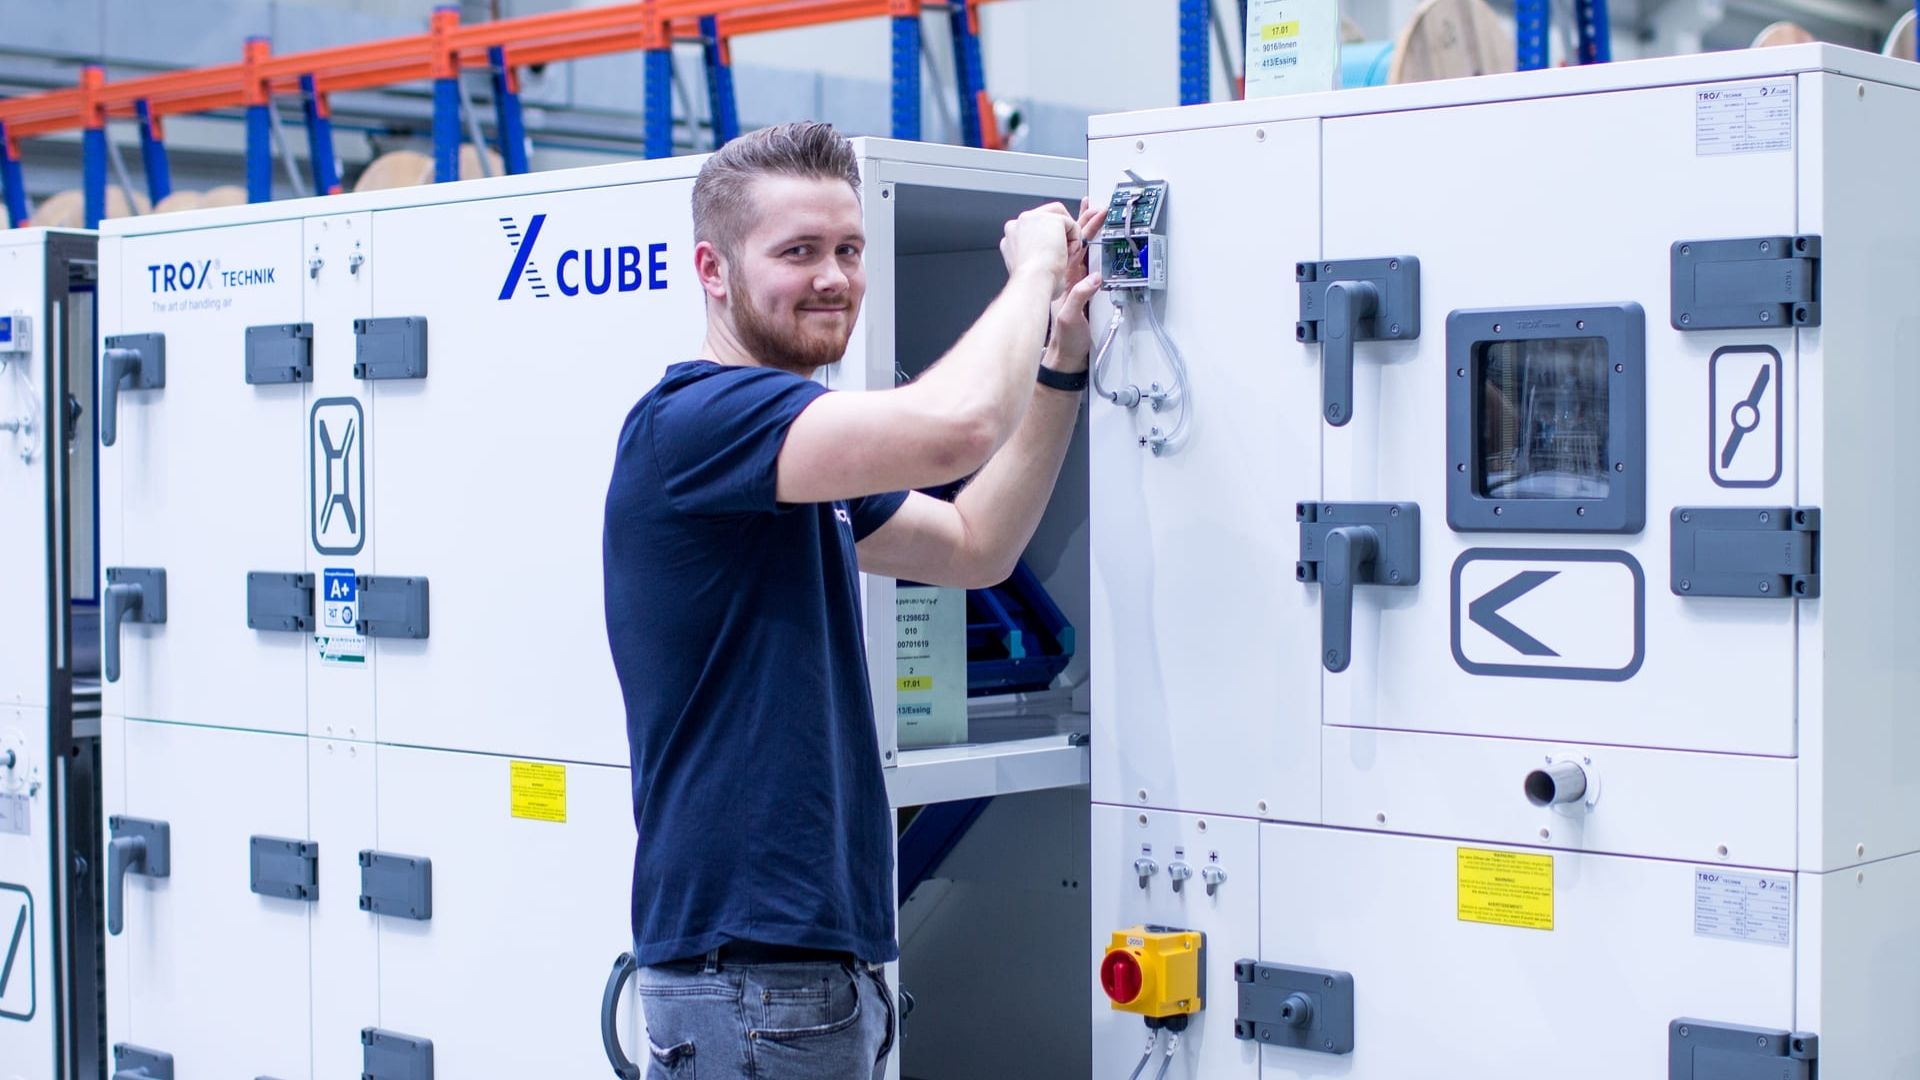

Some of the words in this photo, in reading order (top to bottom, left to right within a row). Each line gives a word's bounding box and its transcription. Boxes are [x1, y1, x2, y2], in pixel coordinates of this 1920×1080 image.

[1272, 26, 1288, 36] 17.01
[1263, 41, 1297, 52] 9016/Innen
[1262, 56, 1297, 67] 413/Essing
[557, 243, 668, 297] CUBE
[222, 268, 275, 287] TECHNIK
[152, 301, 166, 312] The
[168, 301, 178, 312] art
[180, 299, 188, 311] of
[189, 298, 221, 311] handling
[222, 298, 232, 308] air
[330, 578, 350, 599] A+
[905, 627, 918, 635] 010
[909, 667, 914, 675] 2
[903, 680, 920, 688] 17.01
